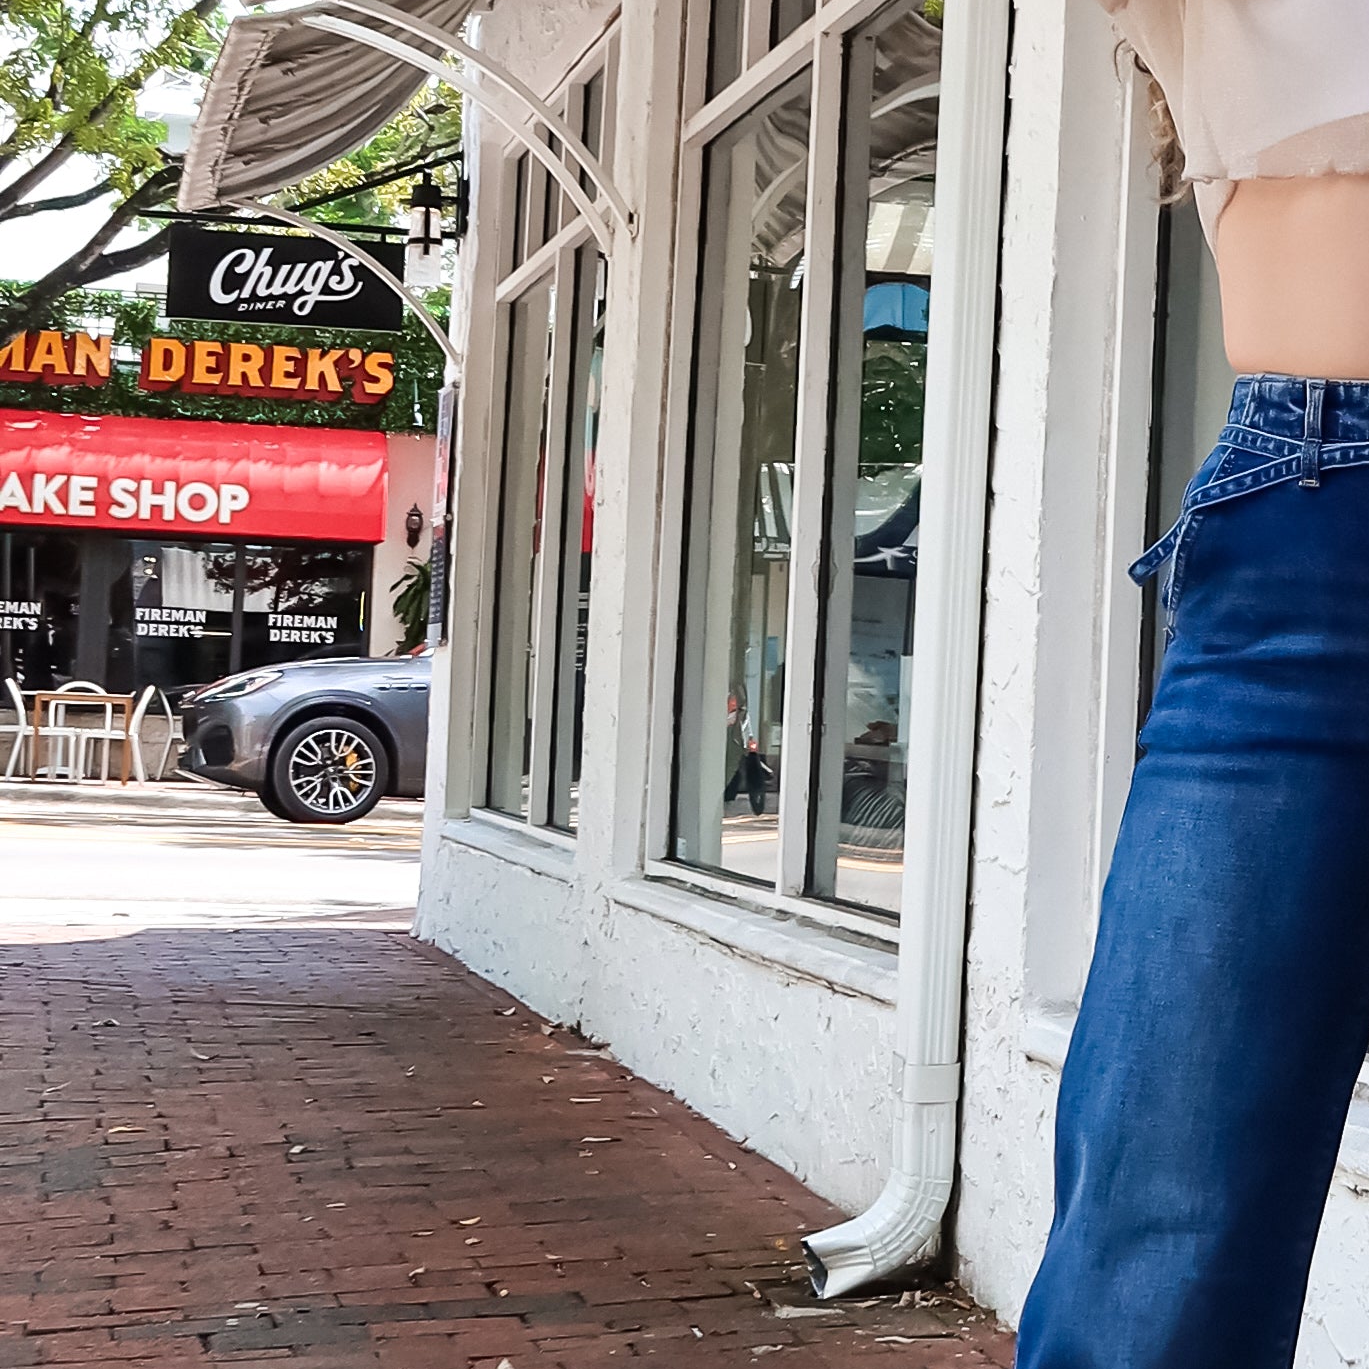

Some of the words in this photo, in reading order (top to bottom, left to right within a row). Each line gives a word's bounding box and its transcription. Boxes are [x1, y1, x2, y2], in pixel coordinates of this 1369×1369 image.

[209, 247, 364, 316] Chug's
[237, 300, 286, 312] DINER
[147, 337, 395, 395] DEREK'S
[0, 471, 98, 517] AKE
[108, 476, 251, 524] SHOP
[134, 607, 207, 624] FIREMAN
[267, 614, 338, 629] FIREMAN
[136, 623, 205, 638] DEREK'S
[269, 629, 336, 645] DEREK'S
